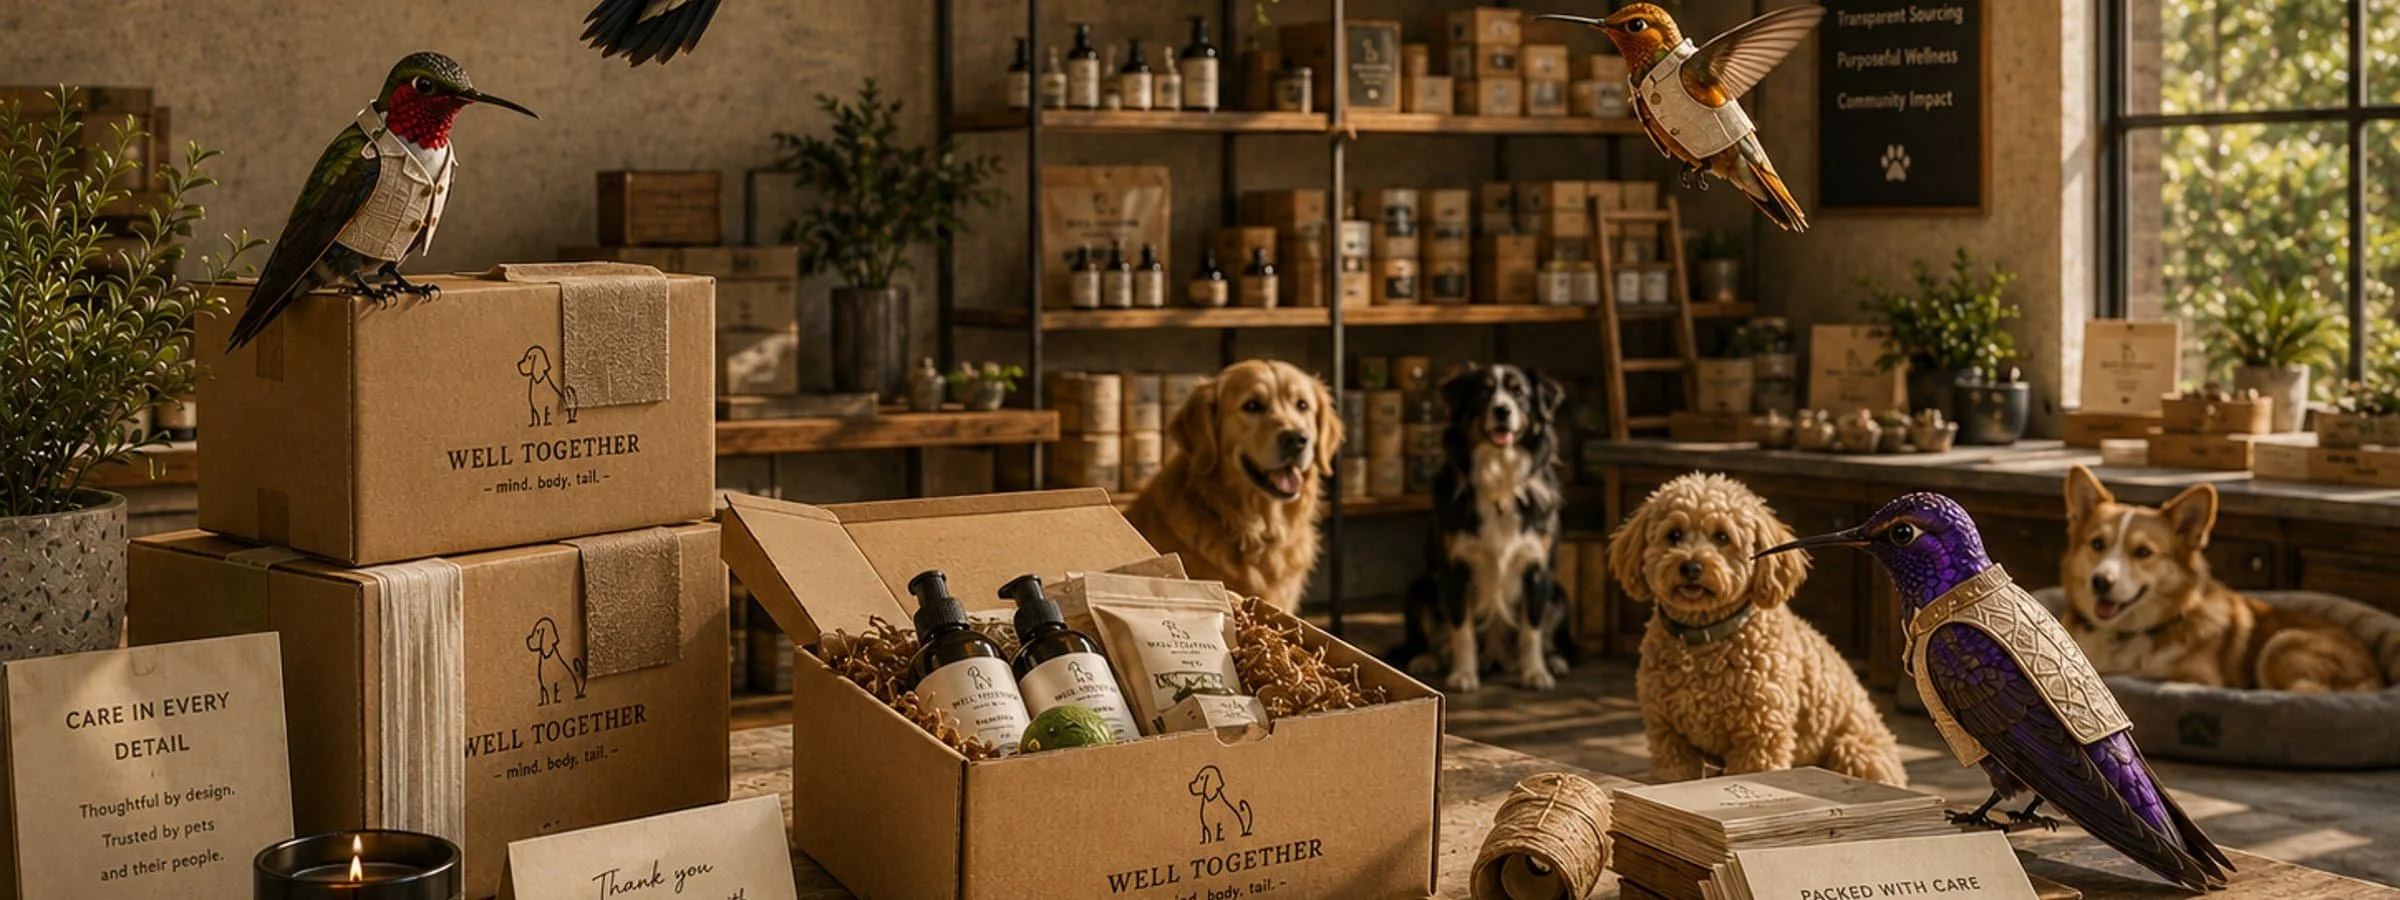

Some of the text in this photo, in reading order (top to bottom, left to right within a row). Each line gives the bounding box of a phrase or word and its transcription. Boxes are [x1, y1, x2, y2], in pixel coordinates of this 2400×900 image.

[1837, 4, 1963, 30] Transparent Sourcing
[1837, 46, 1959, 72] Purposeful Wellness
[1837, 90, 1953, 112] Community Impact
[448, 434, 640, 470] WELL TOGETHER
[496, 470, 600, 493] mind. body. tail.
[66, 691, 230, 729] CARE IN EVERY
[464, 704, 647, 759] WELL TOGETHER
[115, 734, 190, 760] DETAIL
[506, 744, 608, 780] mind. body. tail.
[79, 784, 235, 819] Thoughtful by design.
[102, 820, 215, 848] Trusted by pets
[101, 848, 224, 881] and their people.
[1107, 838, 1323, 895] WELL TOGETHER
[592, 860, 714, 900] Thank you
[1249, 878, 1275, 894] tail.
[1800, 876, 1981, 900] PACKED WITH CARE
